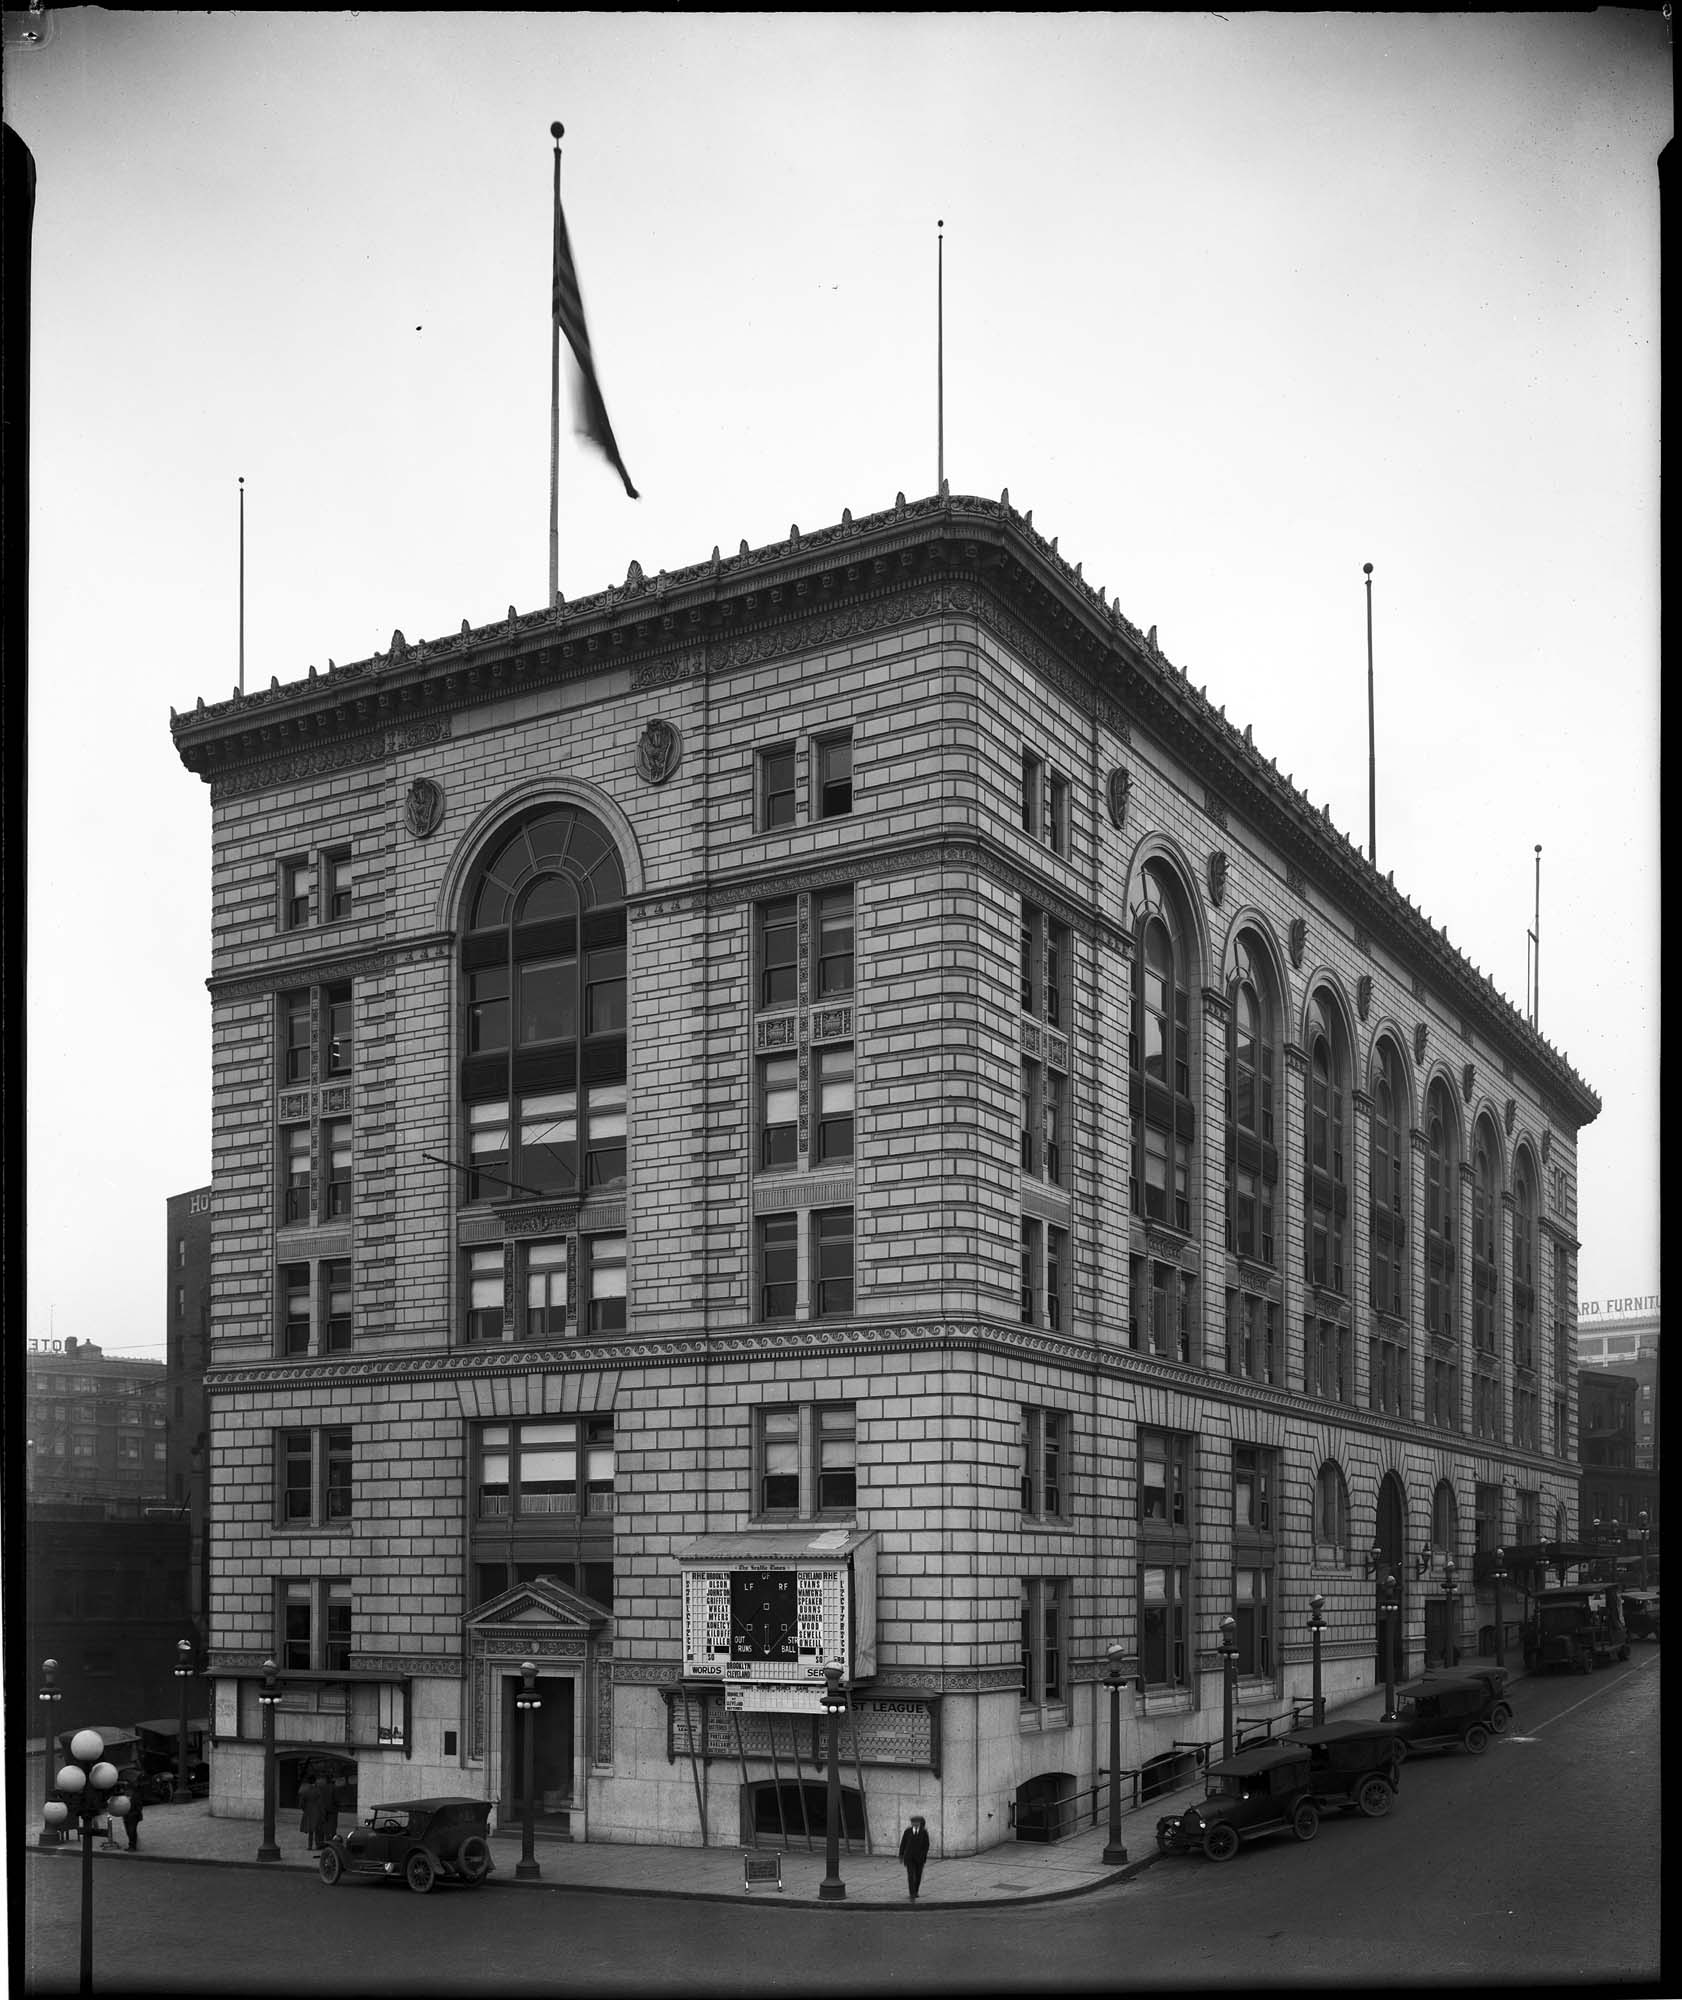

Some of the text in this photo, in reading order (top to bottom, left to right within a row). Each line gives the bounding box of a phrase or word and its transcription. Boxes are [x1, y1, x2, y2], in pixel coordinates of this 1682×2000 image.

[190, 1194, 209, 1214] HO
[707, 1572, 730, 1580] BROOKLYN
[798, 1572, 823, 1580] CLEVELAND
[709, 1580, 728, 1588] OLSON
[744, 1583, 755, 1591] LF
[778, 1583, 789, 1591] RF
[800, 1580, 820, 1588] EVANS
[798, 1597, 823, 1605] SPEAKER
[798, 1614, 823, 1622] GARDNER
[802, 1622, 819, 1630] WOOD
[734, 1635, 745, 1643] OUT
[799, 1631, 821, 1639] SEWELL
[737, 1645, 753, 1653] RUNS
[781, 1645, 796, 1653] BALL
[692, 1666, 825, 1677] WORLDS SER
[727, 1670, 751, 1678] CLEVELAND
[873, 1703, 924, 1713] LEAGUE
